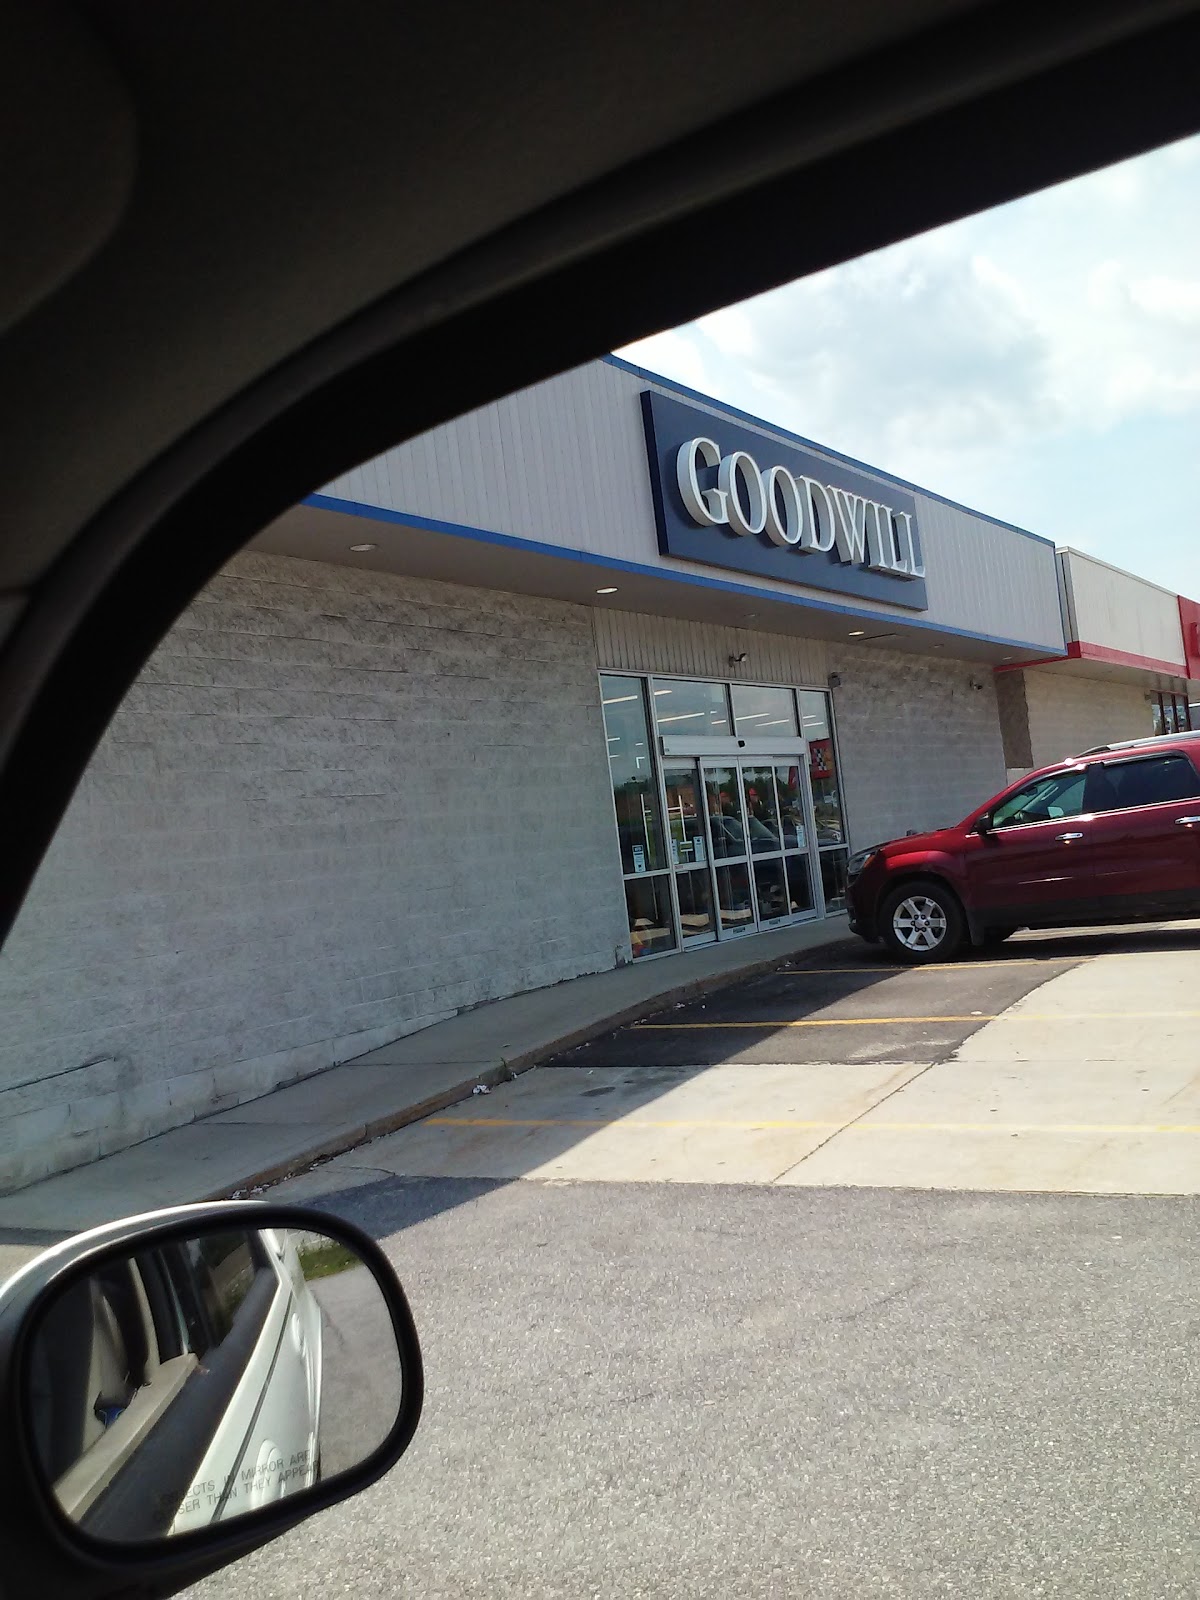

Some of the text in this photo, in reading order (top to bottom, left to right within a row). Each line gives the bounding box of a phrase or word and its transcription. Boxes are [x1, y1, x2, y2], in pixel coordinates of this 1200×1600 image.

[677, 437, 925, 580] GOODWILL
[241, 1459, 284, 1480] MIRROR
[290, 1449, 311, 1466] ARE
[244, 1475, 271, 1493] THEY
